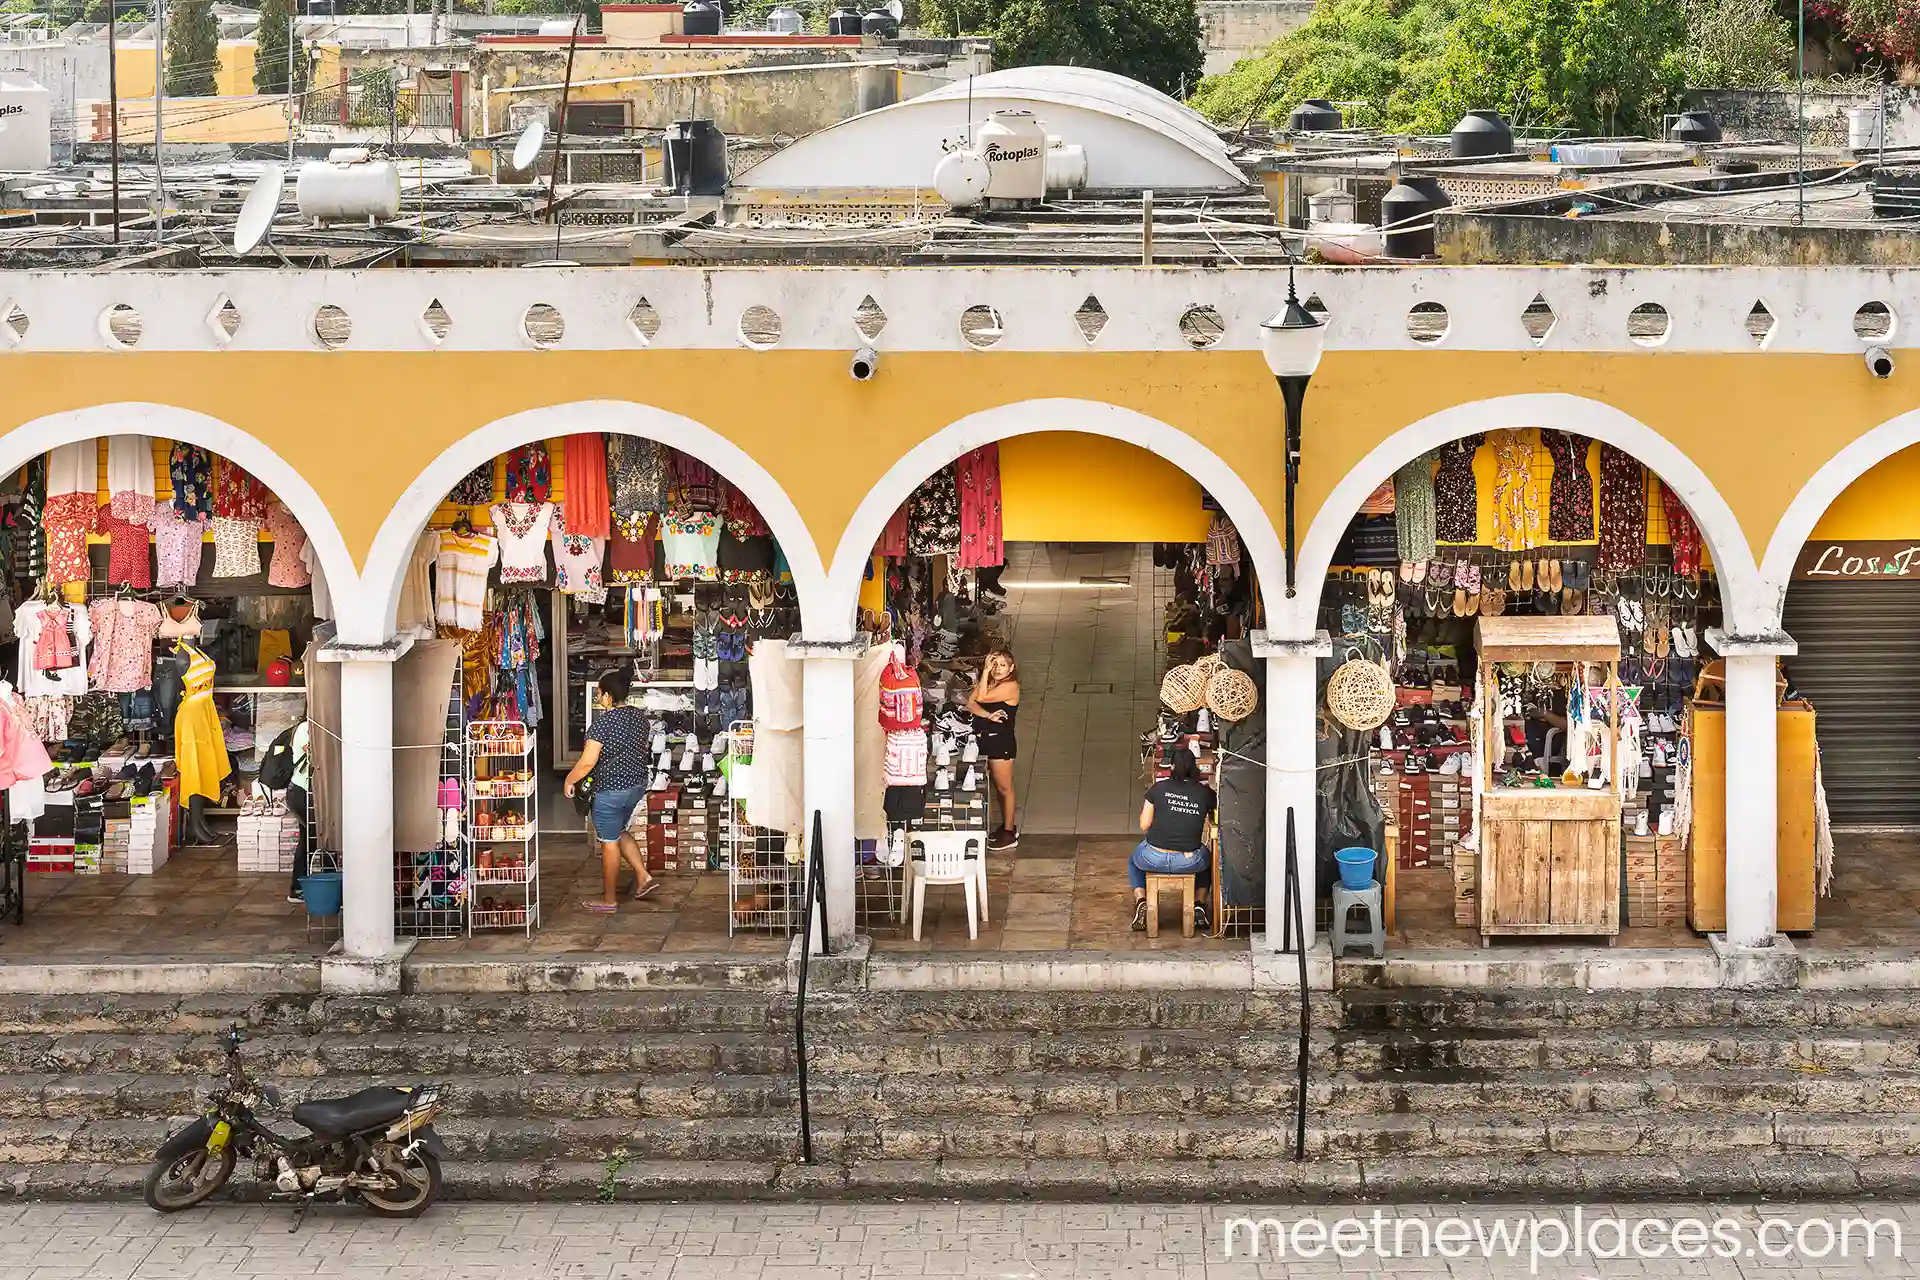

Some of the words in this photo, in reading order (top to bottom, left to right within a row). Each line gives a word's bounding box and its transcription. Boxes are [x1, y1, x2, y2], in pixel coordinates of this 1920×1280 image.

[989, 147, 1039, 162] Rotoplas
[1806, 545, 1880, 575] Los
[1164, 792, 1188, 800] HONOR
[1167, 799, 1199, 808] LEALTAD
[1170, 806, 1200, 815] JUSTICIA
